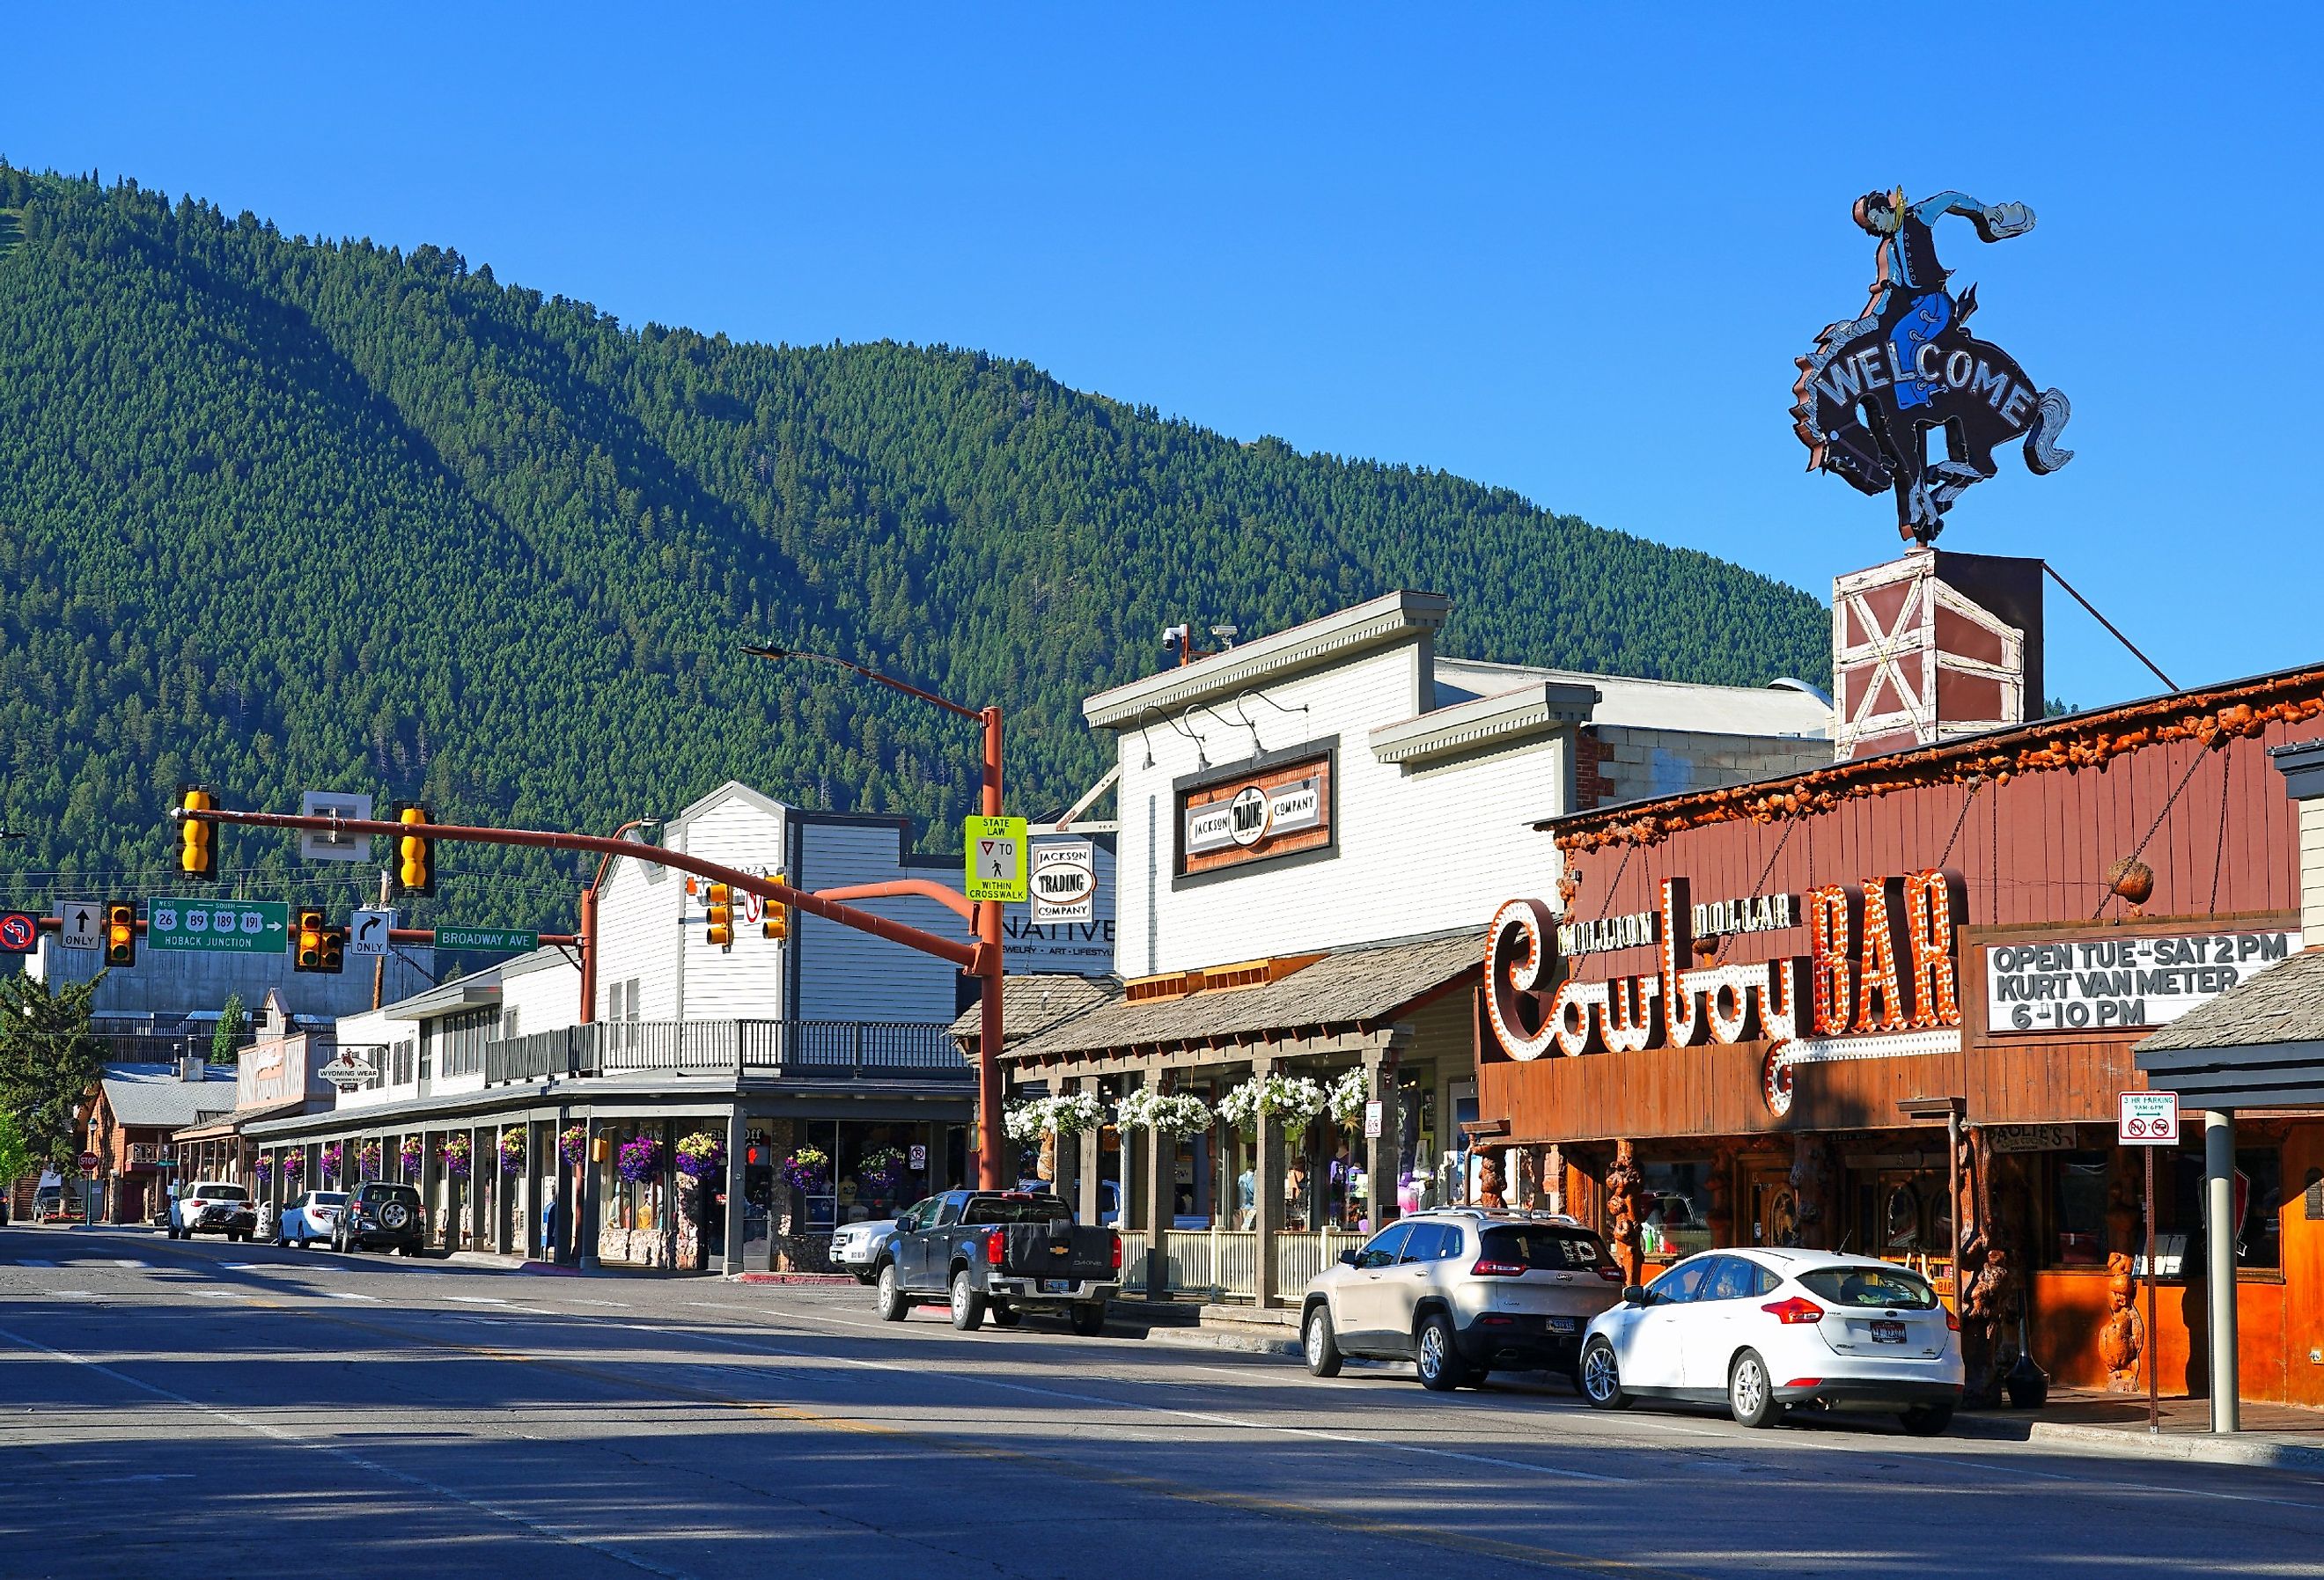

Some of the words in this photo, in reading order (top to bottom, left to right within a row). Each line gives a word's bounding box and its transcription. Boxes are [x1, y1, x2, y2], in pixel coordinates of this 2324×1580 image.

[1815, 342, 2036, 429] WELCOME
[982, 819, 1010, 827] STATE
[1195, 817, 1228, 838] JACKSON
[1233, 801, 1262, 832] TRADING
[1275, 796, 1314, 816] COMPANY
[998, 843, 1012, 856] TO
[1039, 851, 1087, 863] JACKSON
[1038, 874, 1085, 893] TRADING
[969, 889, 1024, 899] CROSSWALK
[1038, 905, 1087, 916] COMPANY
[1691, 893, 1792, 939] DOLLAR
[159, 914, 173, 925] 26
[190, 915, 204, 926] 89
[217, 915, 232, 928] 189
[246, 916, 258, 929] 191
[65, 936, 93, 945] ONLY
[165, 936, 202, 946] HOBACK
[207, 937, 252, 947] JUNCTION
[442, 932, 504, 945] BROADWAY
[509, 935, 529, 946] AVE
[357, 943, 383, 952] ONLY
[1002, 945, 1037, 954] EWELRY
[1073, 948, 1114, 957] LIFESTYL
[1807, 869, 1961, 1037] BAR
[1994, 944, 2072, 974] OPEN
[2078, 937, 2210, 969] TUE-SAT
[2214, 937, 2233, 965] 2
[2237, 933, 2288, 962] PM
[1997, 972, 2071, 1002] KURT
[2075, 969, 2132, 999] VAN
[2136, 966, 2239, 996] METER
[2011, 1001, 2090, 1029] 6-10
[2096, 999, 2145, 1026] PM
[79, 1157, 98, 1165] STOP
